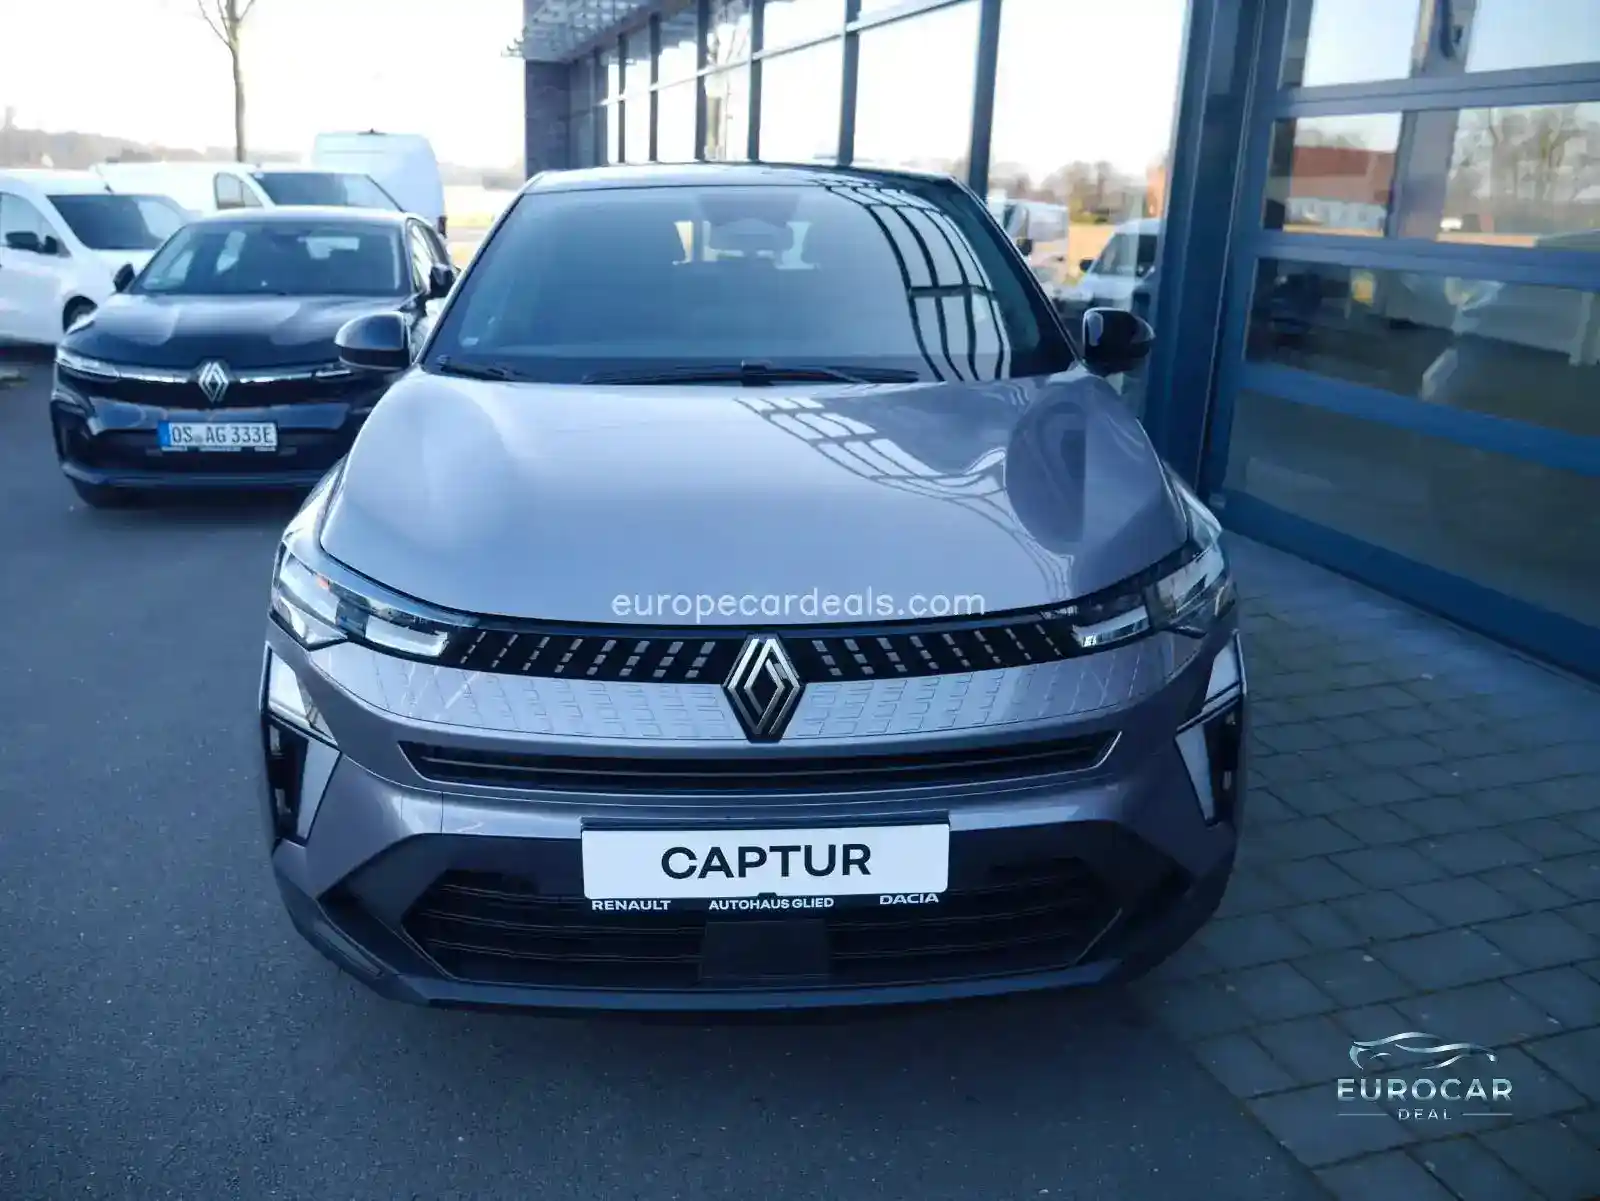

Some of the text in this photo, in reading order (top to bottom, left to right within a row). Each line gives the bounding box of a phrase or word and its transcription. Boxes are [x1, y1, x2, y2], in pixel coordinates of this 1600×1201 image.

[172, 426, 273, 443] OS AG 333E
[661, 843, 872, 880] CAPTUR
[591, 900, 671, 911] RENAULT
[708, 897, 835, 911] AUTOHAUS GLIED
[879, 893, 939, 905] DACIA
